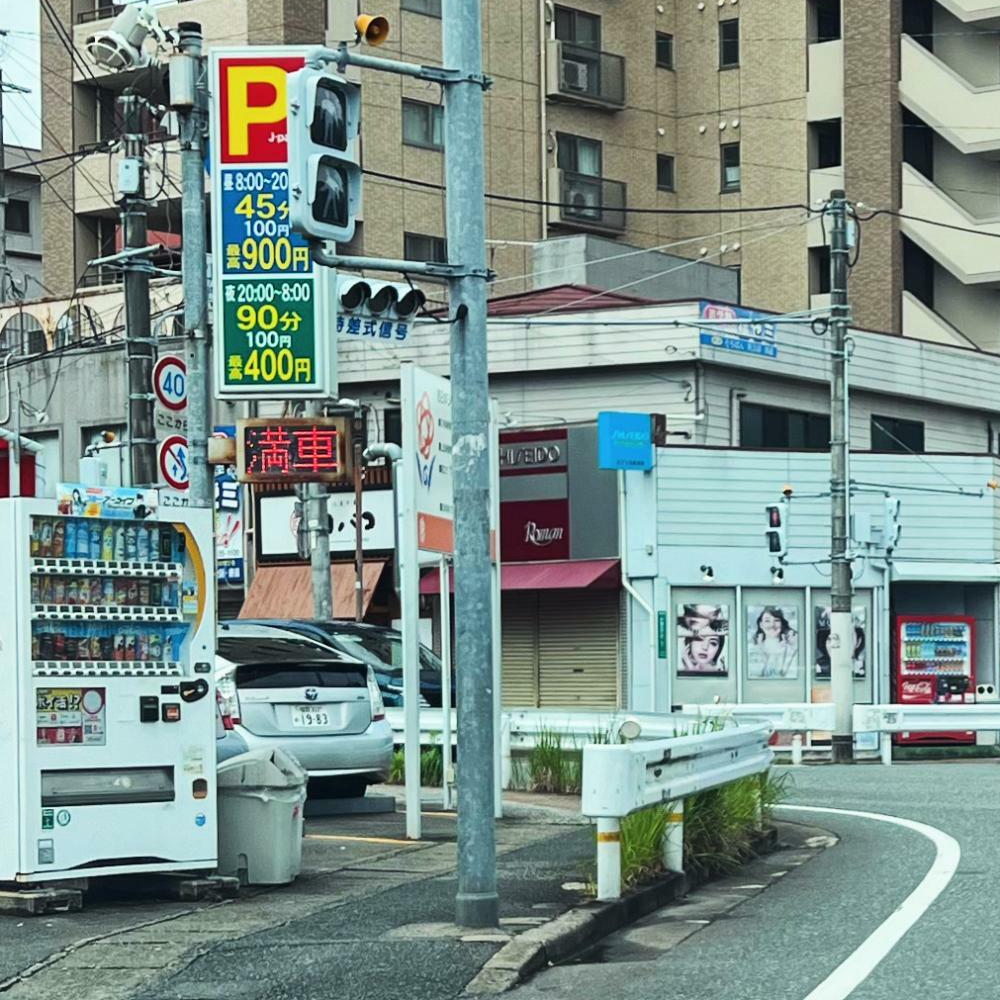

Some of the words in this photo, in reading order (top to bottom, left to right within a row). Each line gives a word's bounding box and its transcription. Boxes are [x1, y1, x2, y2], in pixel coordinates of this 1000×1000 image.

[227, 66, 287, 155] P
[245, 221, 289, 237] 100円
[236, 305, 302, 331] 90分
[246, 331, 292, 348] 100円
[163, 371, 184, 397] 40
[245, 425, 338, 475] 満車
[524, 521, 564, 546] Roman
